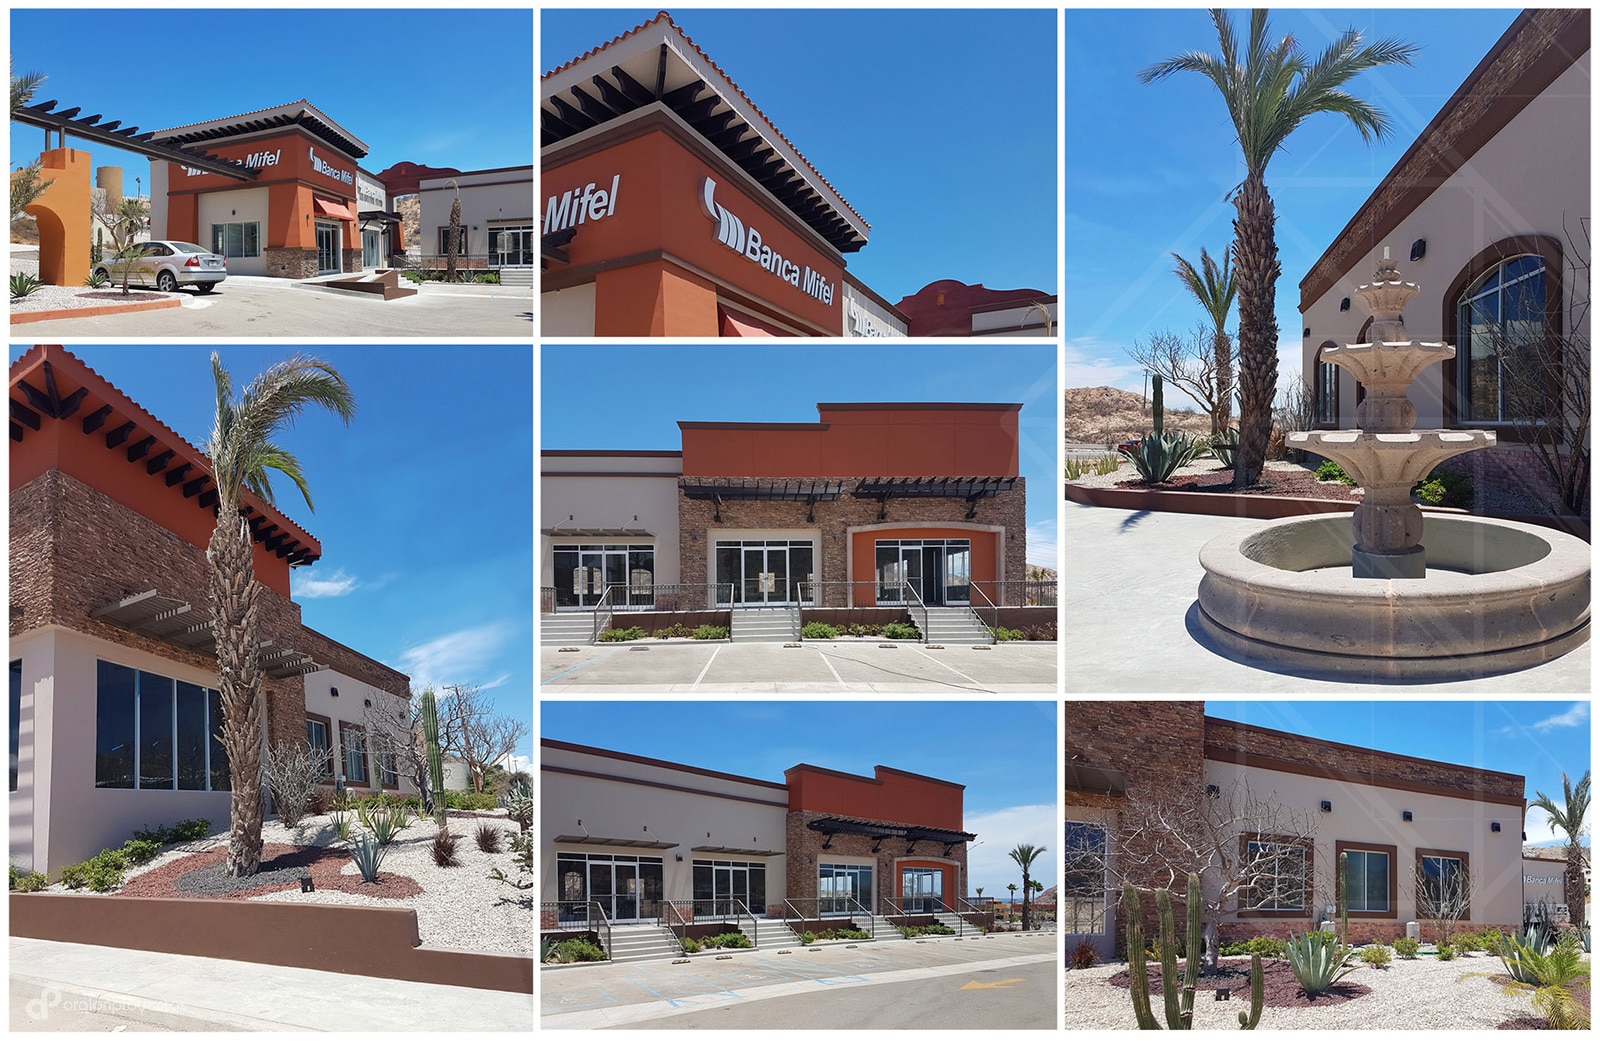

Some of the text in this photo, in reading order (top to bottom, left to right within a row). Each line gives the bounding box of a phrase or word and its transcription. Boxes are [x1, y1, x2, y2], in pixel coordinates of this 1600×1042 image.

[245, 149, 281, 168] Mifel
[322, 160, 354, 186] Banca Mifel
[543, 174, 620, 235] Mifel
[745, 227, 835, 306] Banca Mifel
[1527, 875, 1547, 884] Banca
